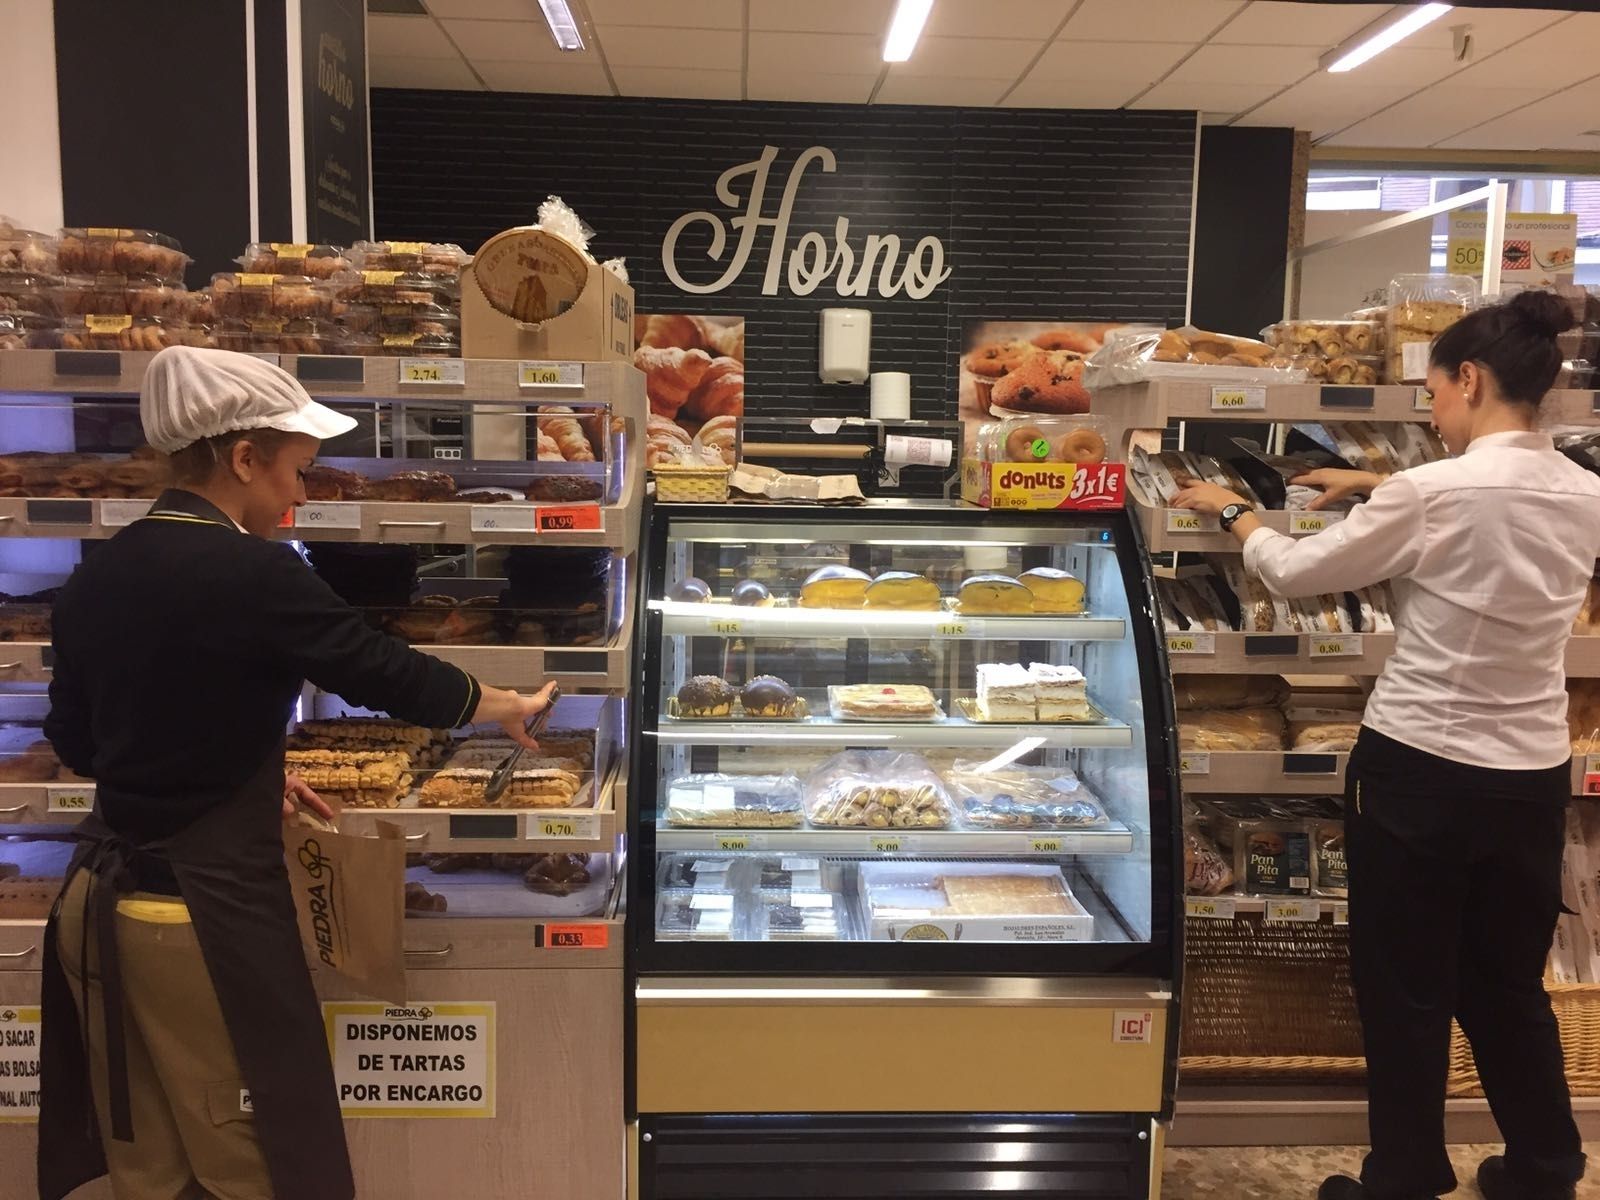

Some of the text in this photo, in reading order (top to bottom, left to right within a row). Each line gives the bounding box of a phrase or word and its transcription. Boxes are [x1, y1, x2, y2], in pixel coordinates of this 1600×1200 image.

[662, 145, 952, 300] Horno
[999, 470, 1066, 490] donuts
[548, 517, 573, 528] 0,99
[1250, 854, 1274, 865] Pan
[1321, 849, 1343, 860] Pan
[1256, 865, 1279, 875] Pita
[1327, 859, 1348, 870] Pita
[308, 884, 336, 968] PIEDRA
[558, 934, 583, 945] 0,33
[385, 1008, 417, 1017] PIEDRA
[346, 1024, 477, 1041] DISPONEMOS
[1121, 1020, 1143, 1034] ICI
[6, 1030, 35, 1047] SACAR
[358, 1054, 465, 1072] DE TARTAS
[341, 1084, 483, 1102] POR ENCARGO
